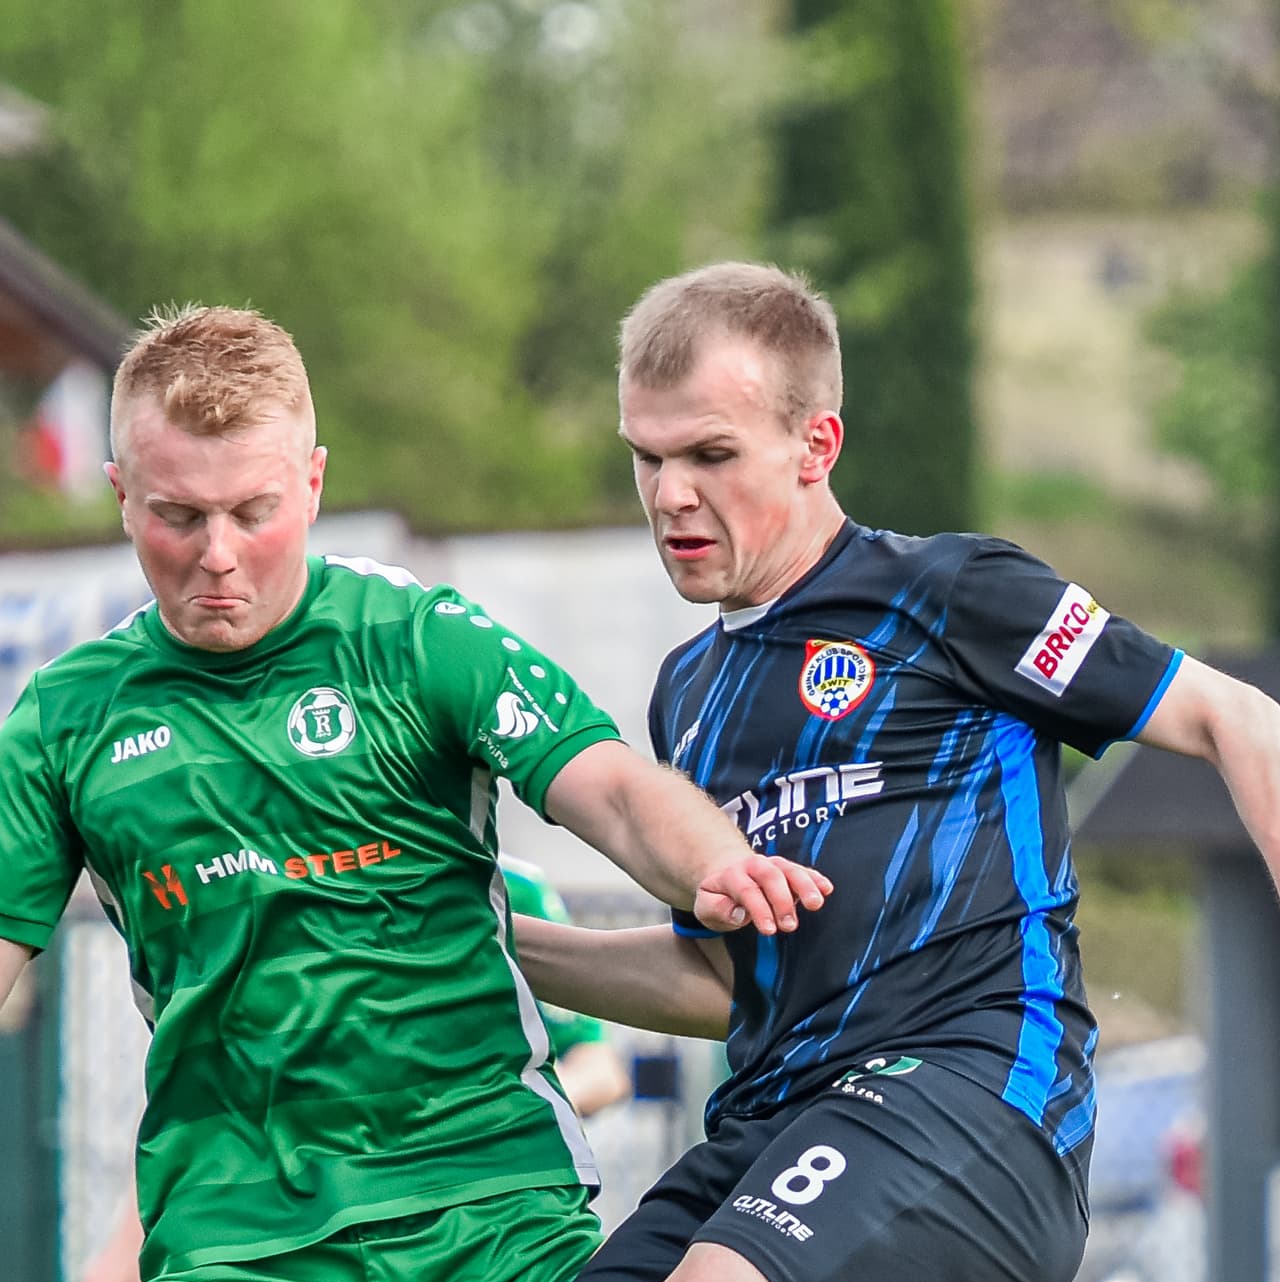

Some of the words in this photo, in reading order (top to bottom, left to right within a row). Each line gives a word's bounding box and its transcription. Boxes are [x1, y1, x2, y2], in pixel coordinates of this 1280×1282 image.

[816, 648, 839, 663] KLUB
[1033, 602, 1090, 679] BRICO
[111, 726, 171, 763] JAKO
[720, 761, 885, 835] TLINE
[750, 801, 848, 849] ACTORY
[195, 849, 278, 884] HMM
[284, 841, 401, 880] STEEL
[771, 1145, 847, 1205] 8
